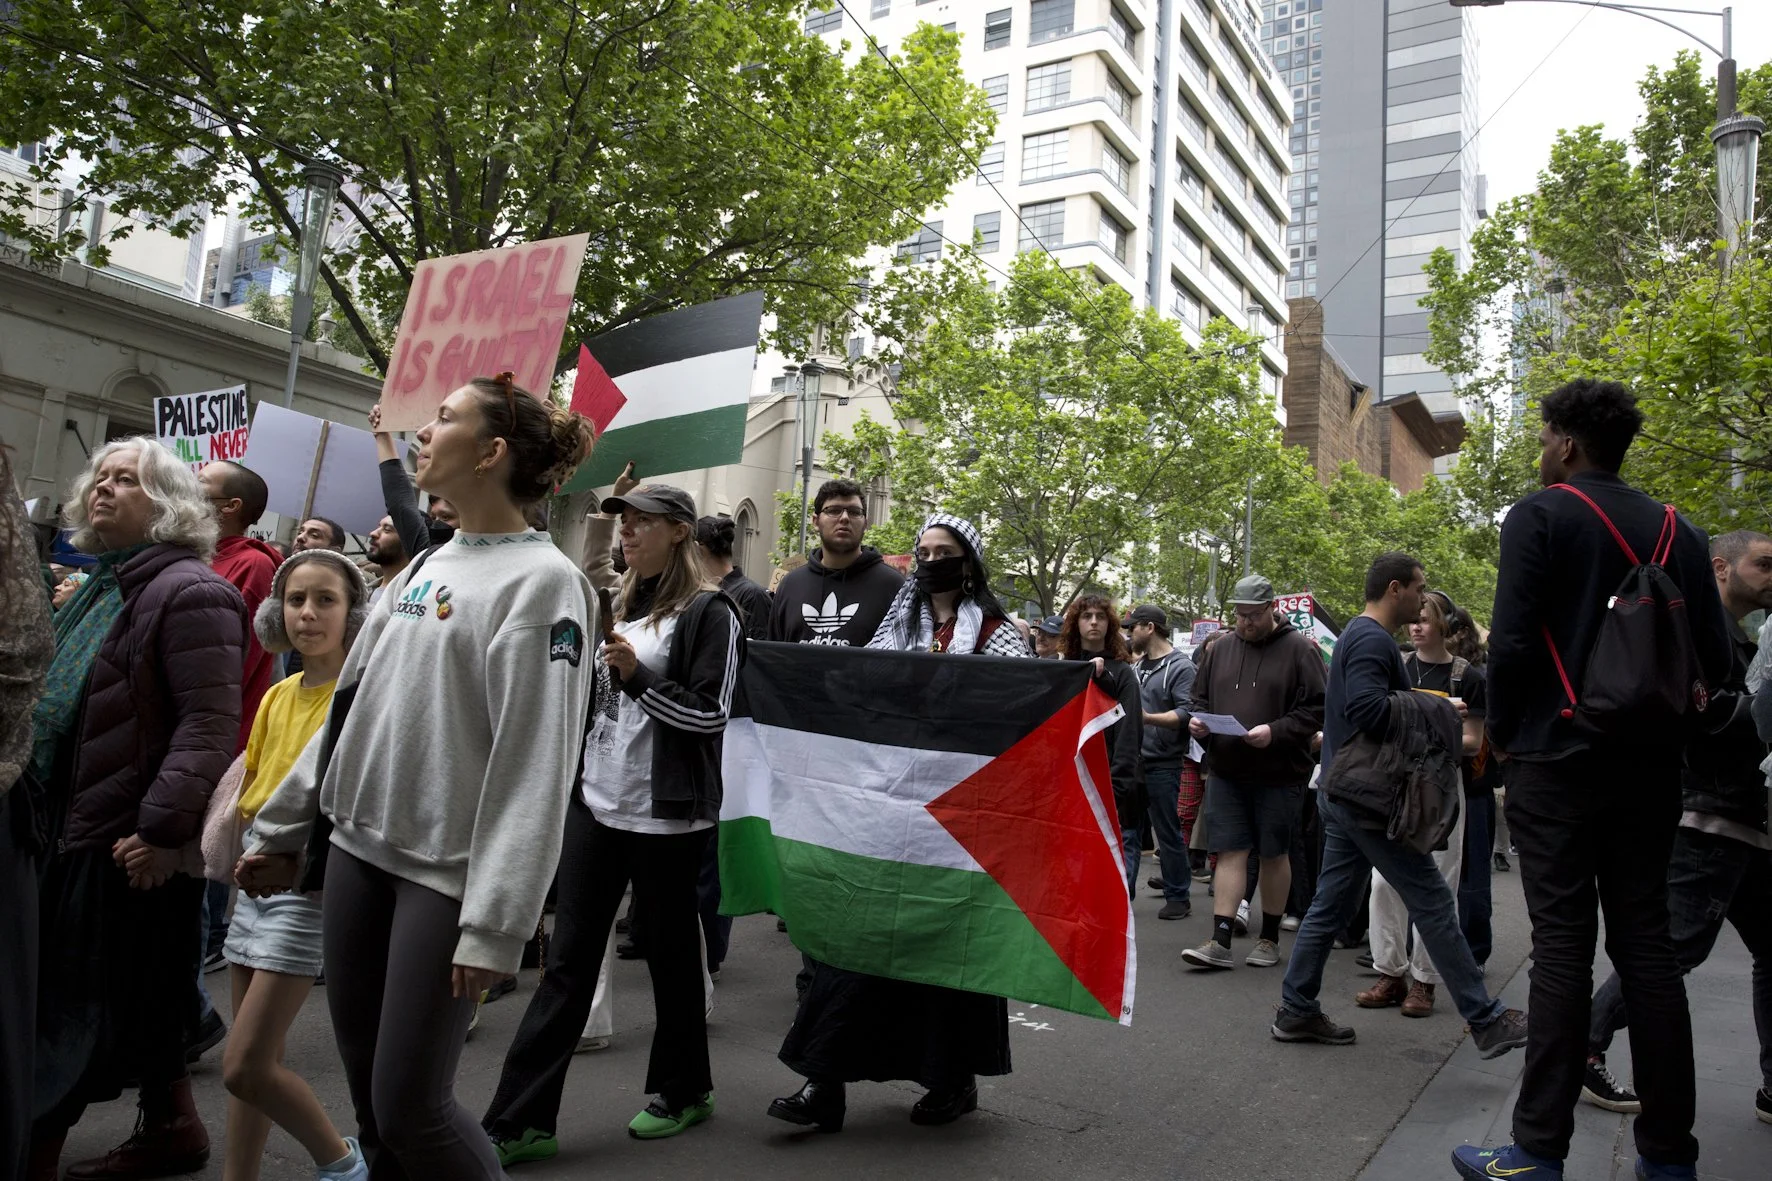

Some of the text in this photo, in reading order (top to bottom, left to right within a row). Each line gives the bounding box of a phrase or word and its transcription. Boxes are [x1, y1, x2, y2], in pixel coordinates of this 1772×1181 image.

[411, 245, 572, 333] ISRAEL
[392, 317, 567, 395] IS GUILTY
[158, 389, 247, 438] PALESTINE
[174, 426, 248, 462] ILL NEVER
[1273, 598, 1311, 614] Ree
[1287, 612, 1312, 628] za
